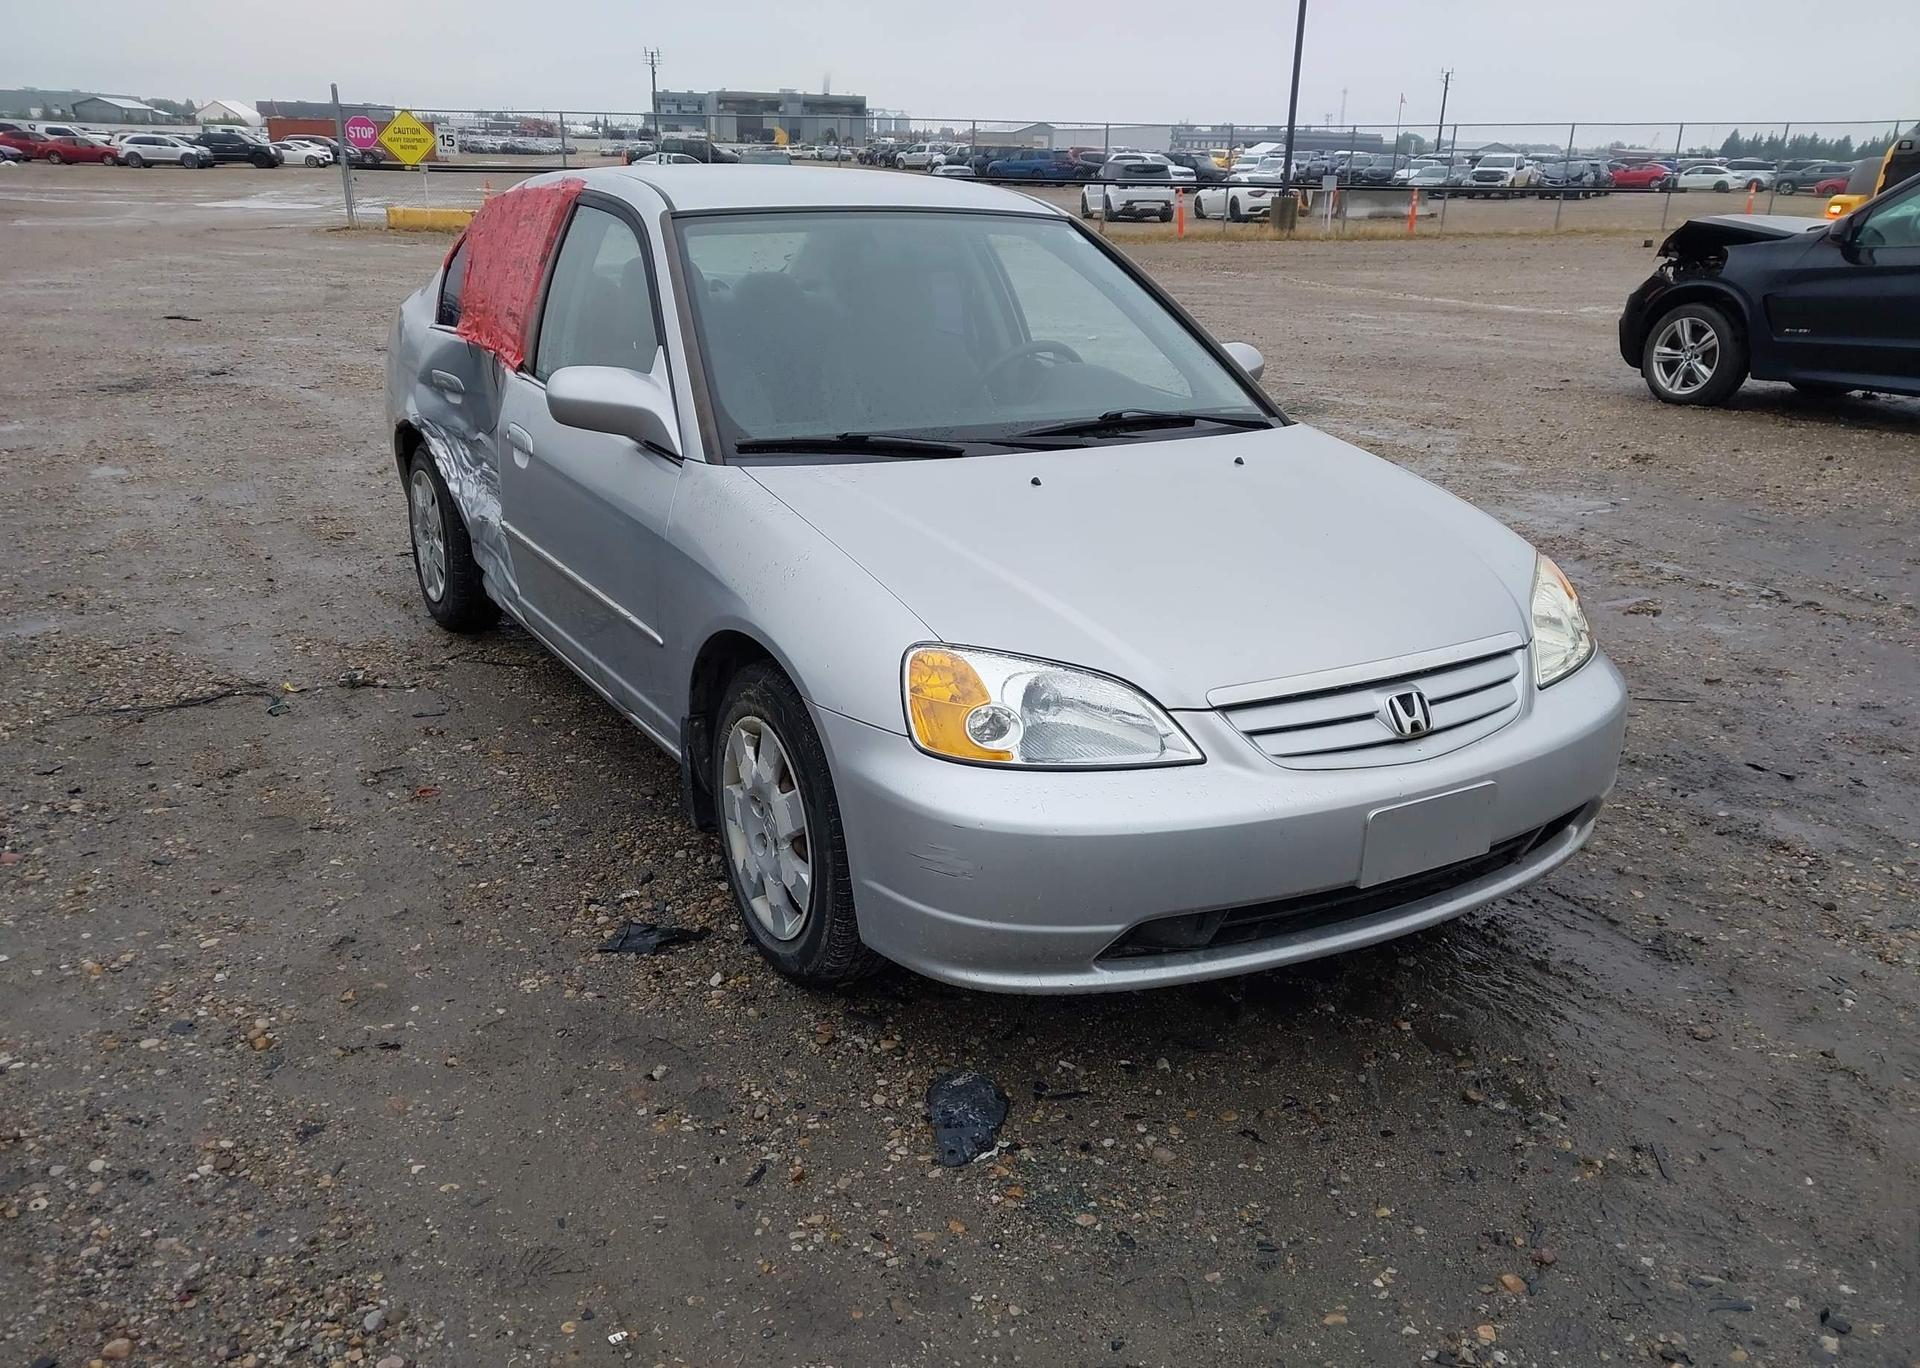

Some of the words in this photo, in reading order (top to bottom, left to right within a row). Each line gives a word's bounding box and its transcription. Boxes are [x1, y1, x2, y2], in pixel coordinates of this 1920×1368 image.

[348, 127, 375, 139] STOP
[393, 127, 421, 135] CAUTION
[439, 134, 455, 147] 15
